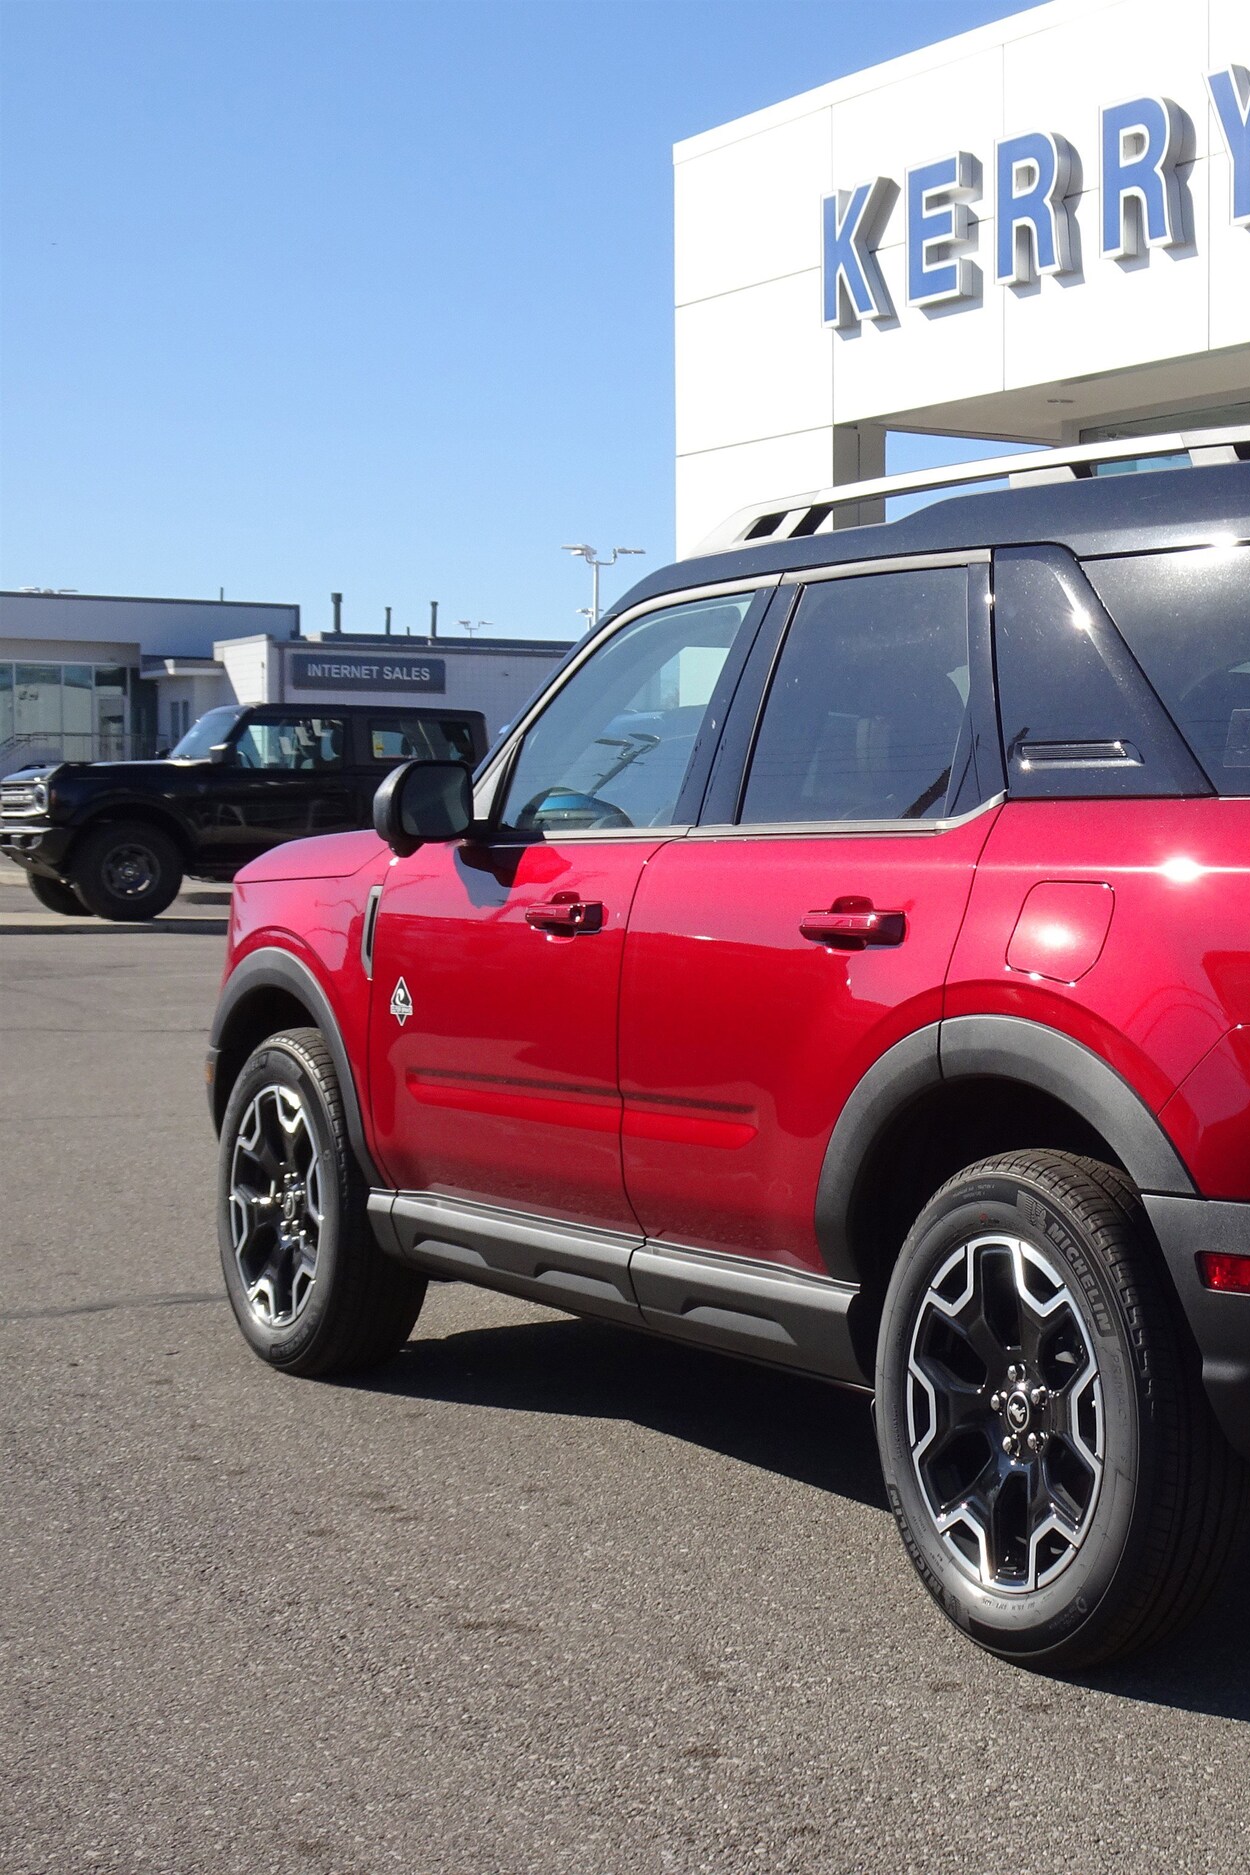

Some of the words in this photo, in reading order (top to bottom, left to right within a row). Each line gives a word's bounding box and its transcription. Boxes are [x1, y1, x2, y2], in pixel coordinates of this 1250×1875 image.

[307, 663, 379, 679] INTERNET
[383, 666, 431, 681] SALES
[1047, 1222, 1111, 1330] MICHELIN
